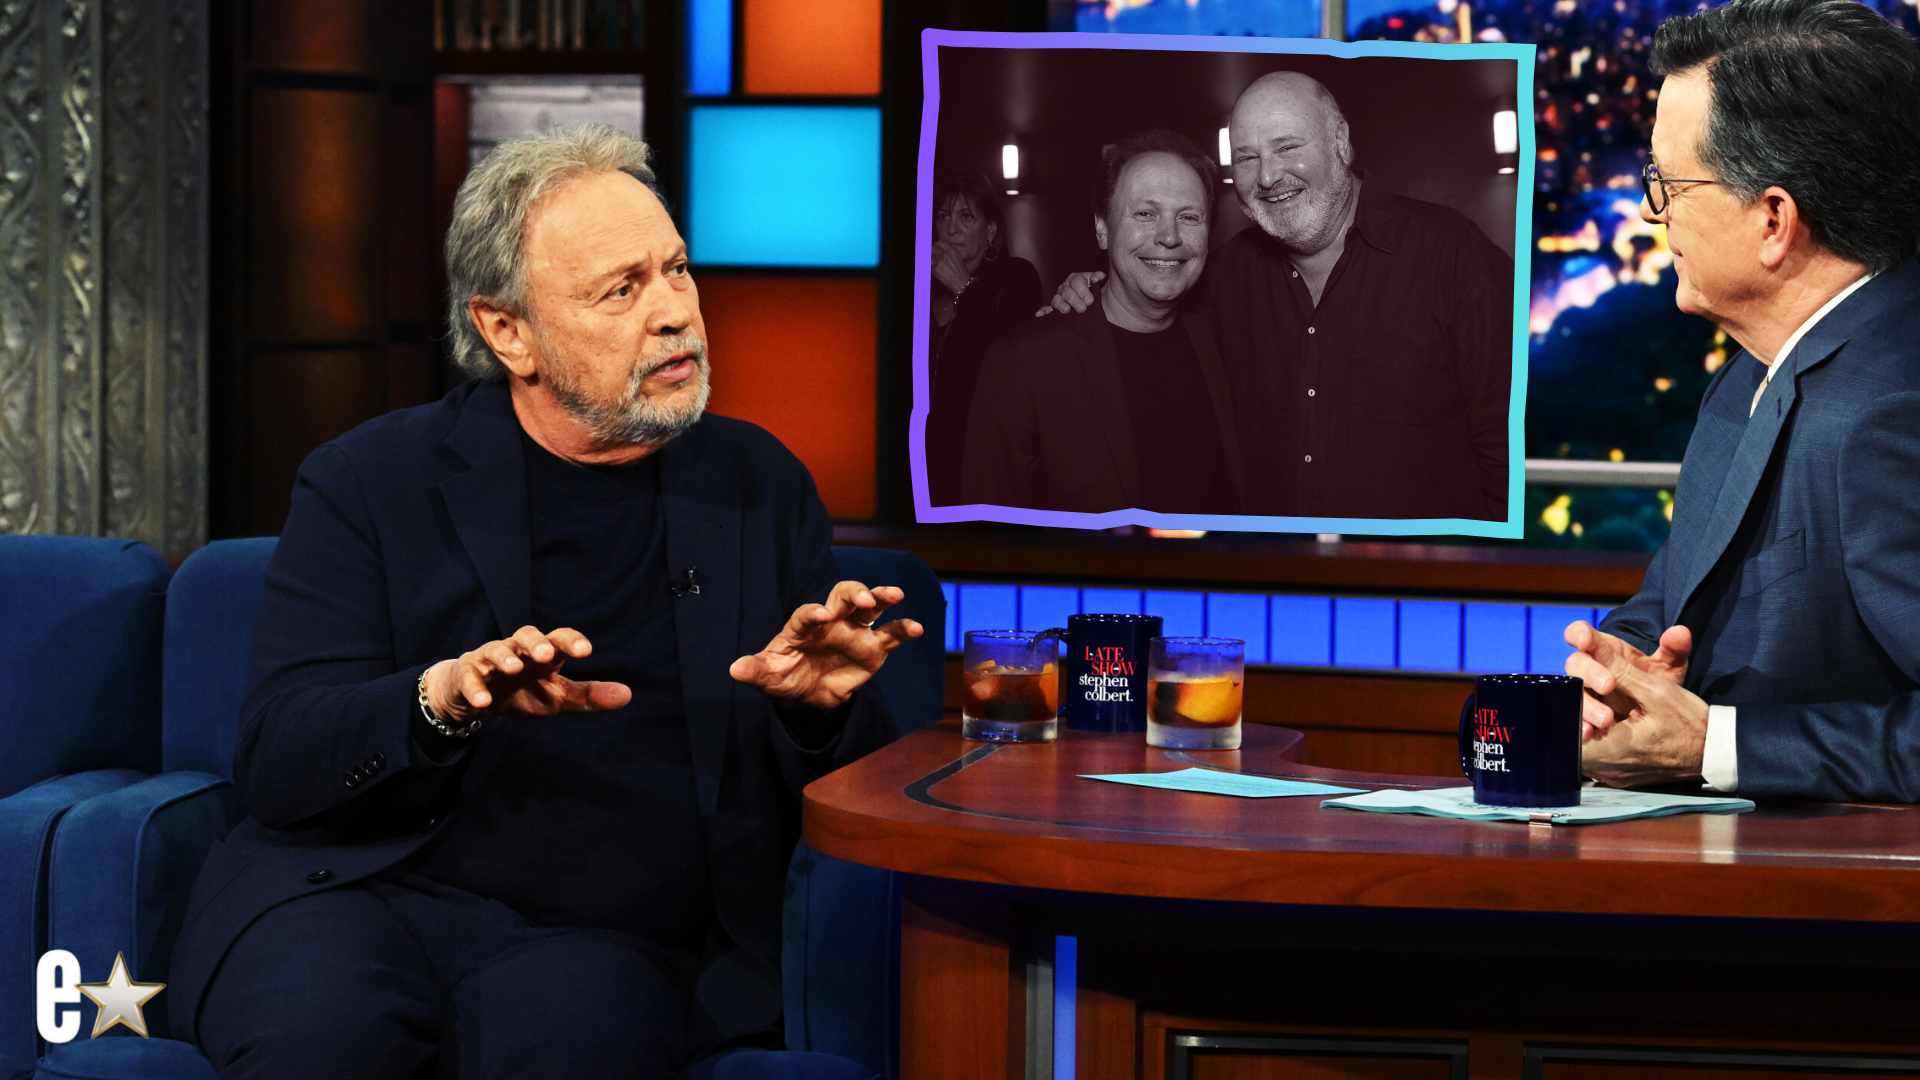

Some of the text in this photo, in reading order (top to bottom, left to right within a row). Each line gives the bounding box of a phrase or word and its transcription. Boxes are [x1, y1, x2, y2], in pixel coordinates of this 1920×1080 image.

[1085, 646, 1125, 662] LATE
[1091, 661, 1138, 676] SHOW
[1079, 672, 1129, 691] stephen
[1084, 686, 1134, 702] colbert.
